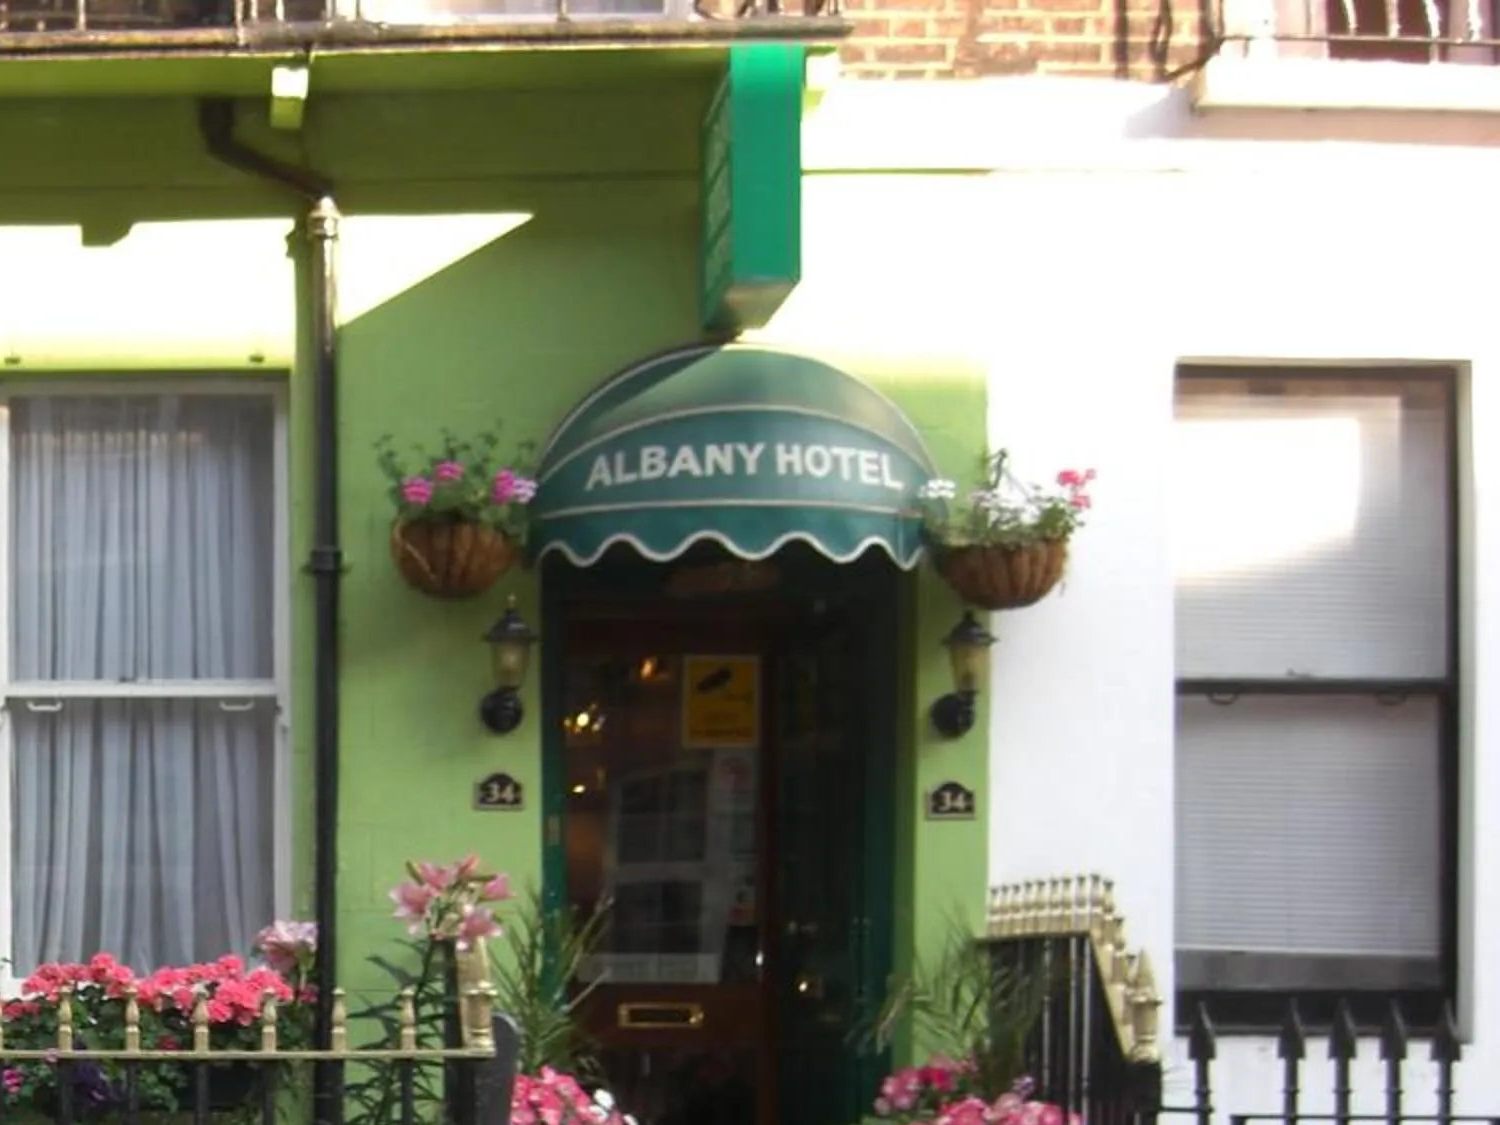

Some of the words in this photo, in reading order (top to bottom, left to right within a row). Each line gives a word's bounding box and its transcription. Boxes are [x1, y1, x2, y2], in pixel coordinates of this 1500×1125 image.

[584, 442, 766, 491] ALBANY
[776, 443, 905, 490] HOTEL
[484, 781, 516, 803] 34
[937, 790, 968, 811] 34
